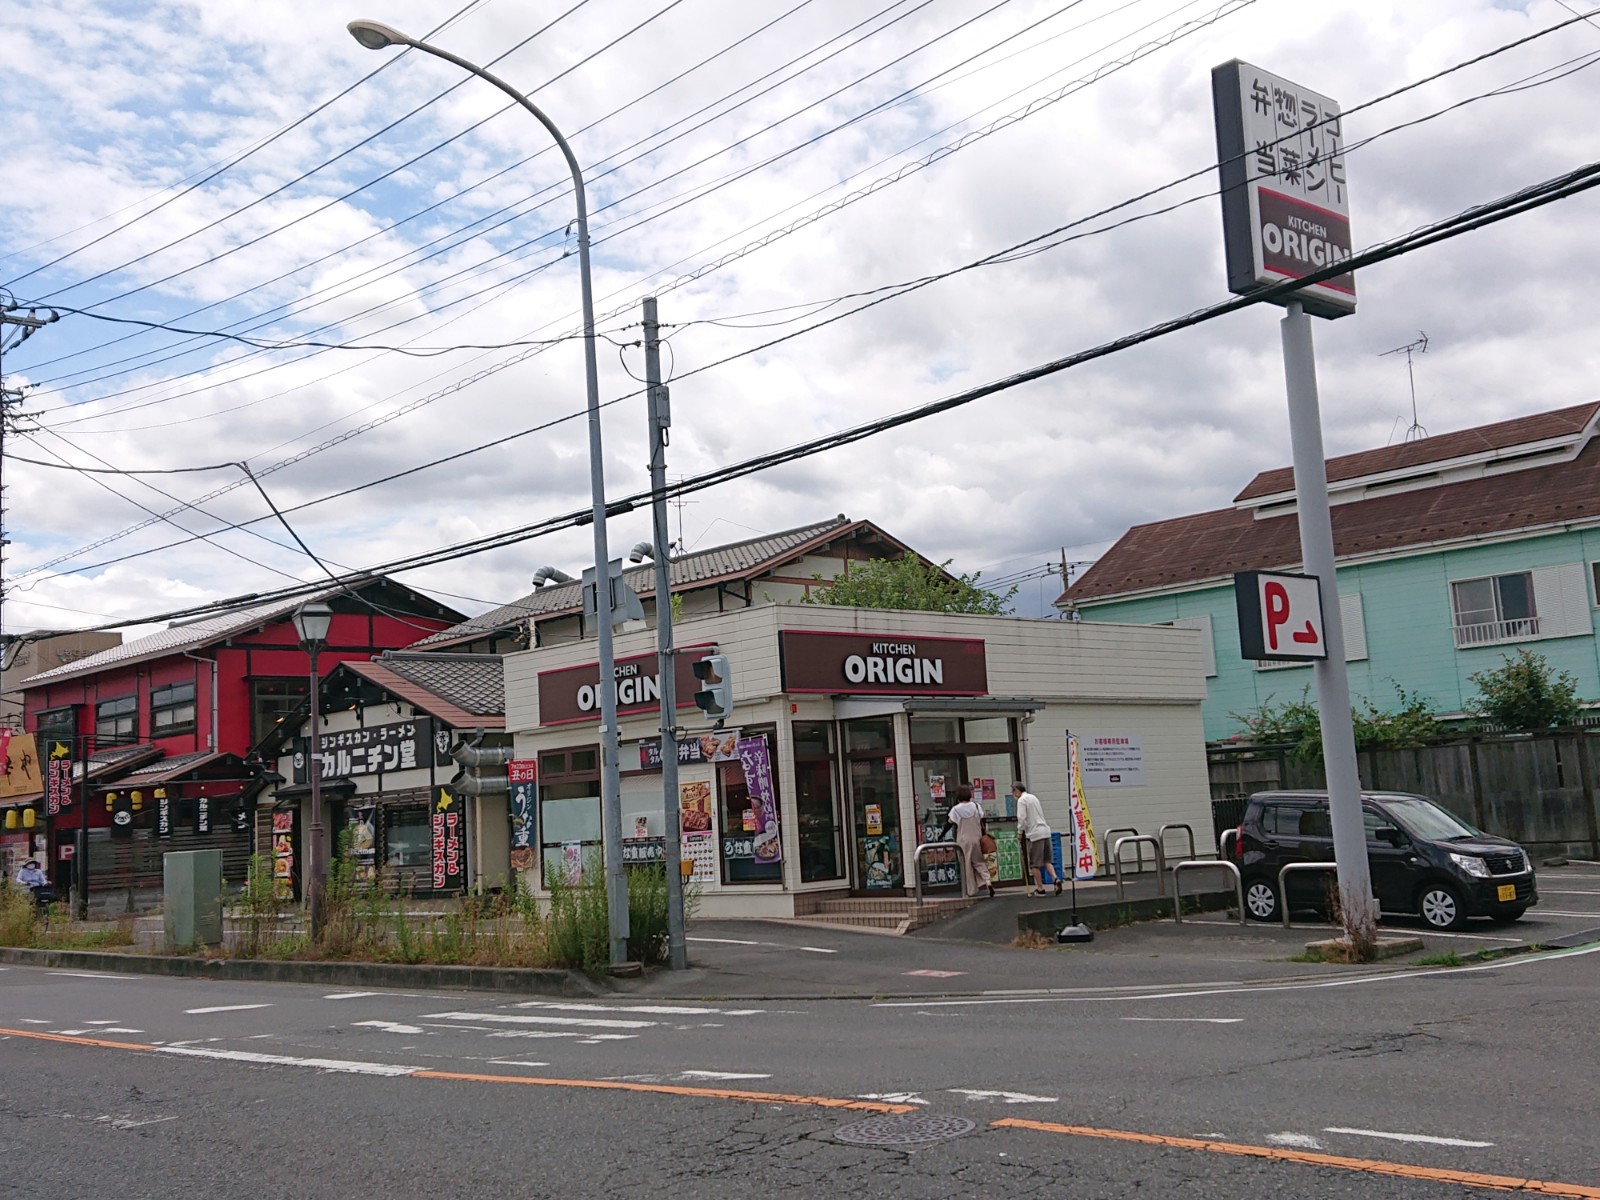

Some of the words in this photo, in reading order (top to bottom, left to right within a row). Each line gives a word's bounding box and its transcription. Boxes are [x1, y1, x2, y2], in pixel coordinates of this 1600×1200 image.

[1250, 78, 1276, 177] 弁当
[1274, 87, 1302, 186] 惣菜
[1300, 99, 1326, 191] ラーメン
[1324, 111, 1346, 204] コーヒー
[1288, 215, 1327, 238] KITCHEN
[1262, 222, 1352, 276] ORIGIN
[1265, 581, 1290, 650] P
[872, 642, 916, 655] KITCHEN
[614, 664, 638, 678] CHEN
[844, 654, 943, 685] ORIGIN
[577, 674, 661, 712] OGIN
[320, 724, 416, 749] ジンギスカン・ラーメン
[678, 742, 701, 761] 弁当
[321, 739, 417, 779] カルニチン堂
[511, 768, 534, 781] 丑の日
[432, 812, 446, 889] ジンギスカン
[446, 812, 459, 876] ラーメン&
